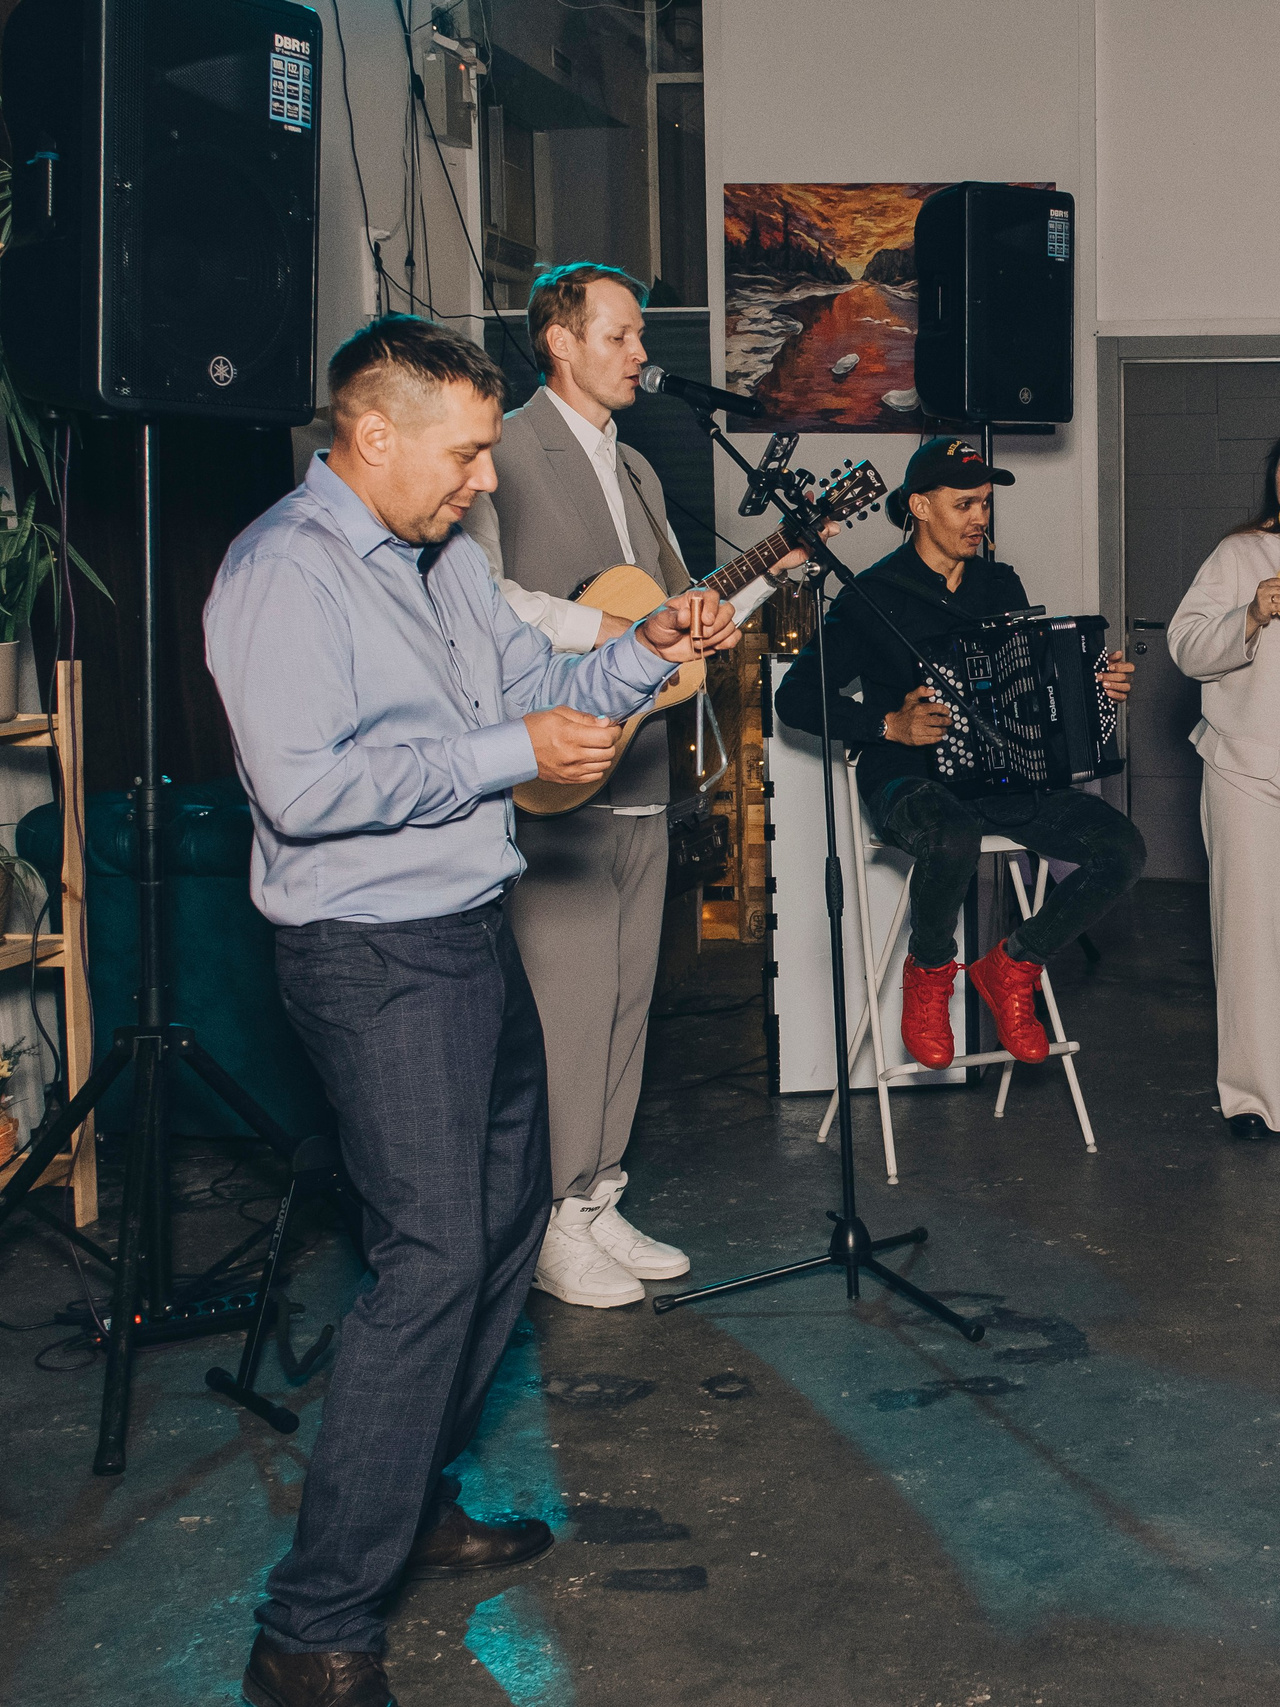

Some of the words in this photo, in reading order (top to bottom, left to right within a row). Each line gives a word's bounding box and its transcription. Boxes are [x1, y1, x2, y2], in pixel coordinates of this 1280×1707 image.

[274, 33, 310, 56] DBR15
[866, 470, 881, 487] Cort
[1046, 685, 1058, 722] Roland
